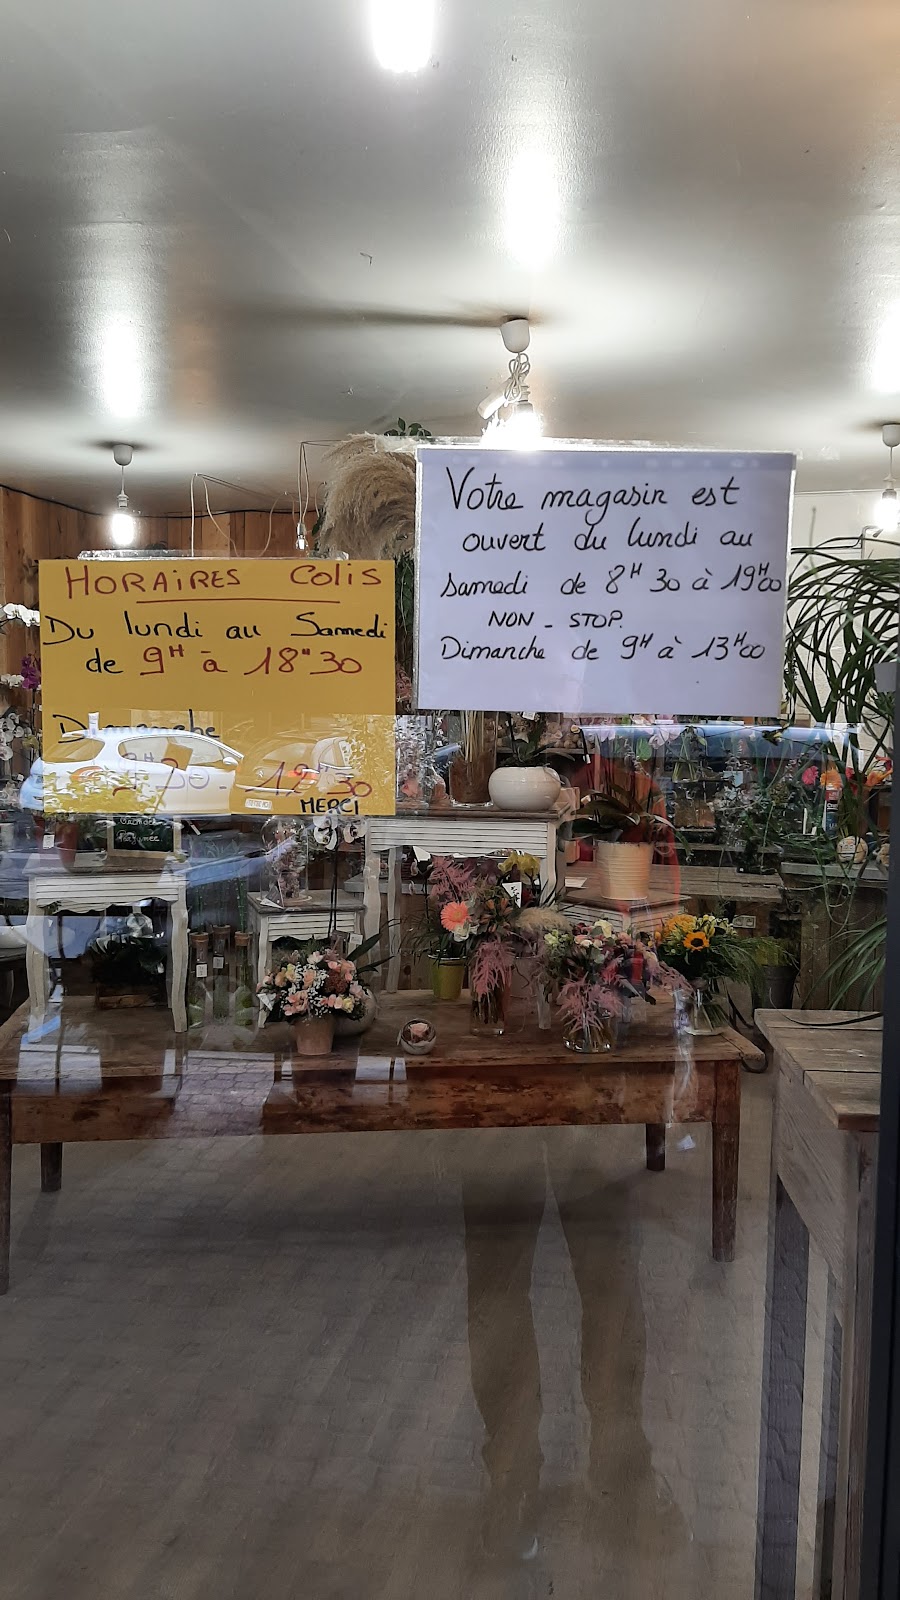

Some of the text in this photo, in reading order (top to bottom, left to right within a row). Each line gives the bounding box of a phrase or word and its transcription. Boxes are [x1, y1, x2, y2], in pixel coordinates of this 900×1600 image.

[446, 467, 740, 526] Votre magasin est
[462, 517, 753, 552] ouvert du lundi au
[290, 563, 382, 586] Colis
[560, 572, 587, 595] de
[692, 567, 713, 591] à
[43, 610, 388, 645] Du lundi au Samedi
[488, 611, 535, 627] NON
[86, 648, 124, 674] de
[140, 644, 184, 676] 9H
[441, 632, 766, 661] Dimanche de 9H à 13H00
[300, 797, 359, 814] MERCI
